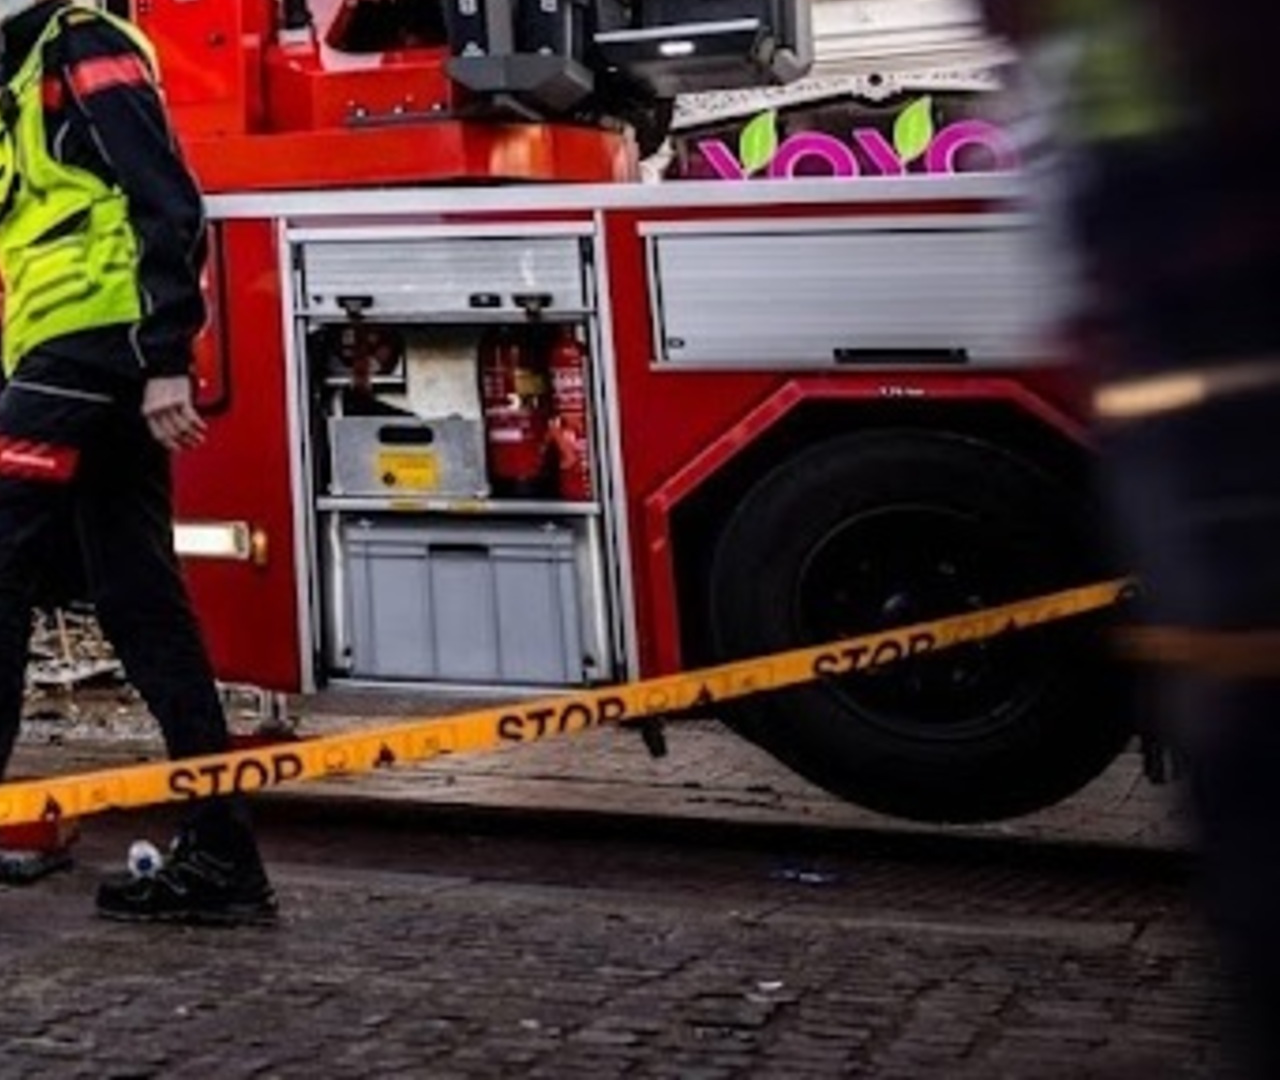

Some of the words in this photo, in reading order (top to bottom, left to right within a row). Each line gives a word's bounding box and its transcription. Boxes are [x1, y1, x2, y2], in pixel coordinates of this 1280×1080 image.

[168, 753, 303, 799] STOP
[497, 696, 626, 743] STOP
[811, 631, 937, 678] STOP
